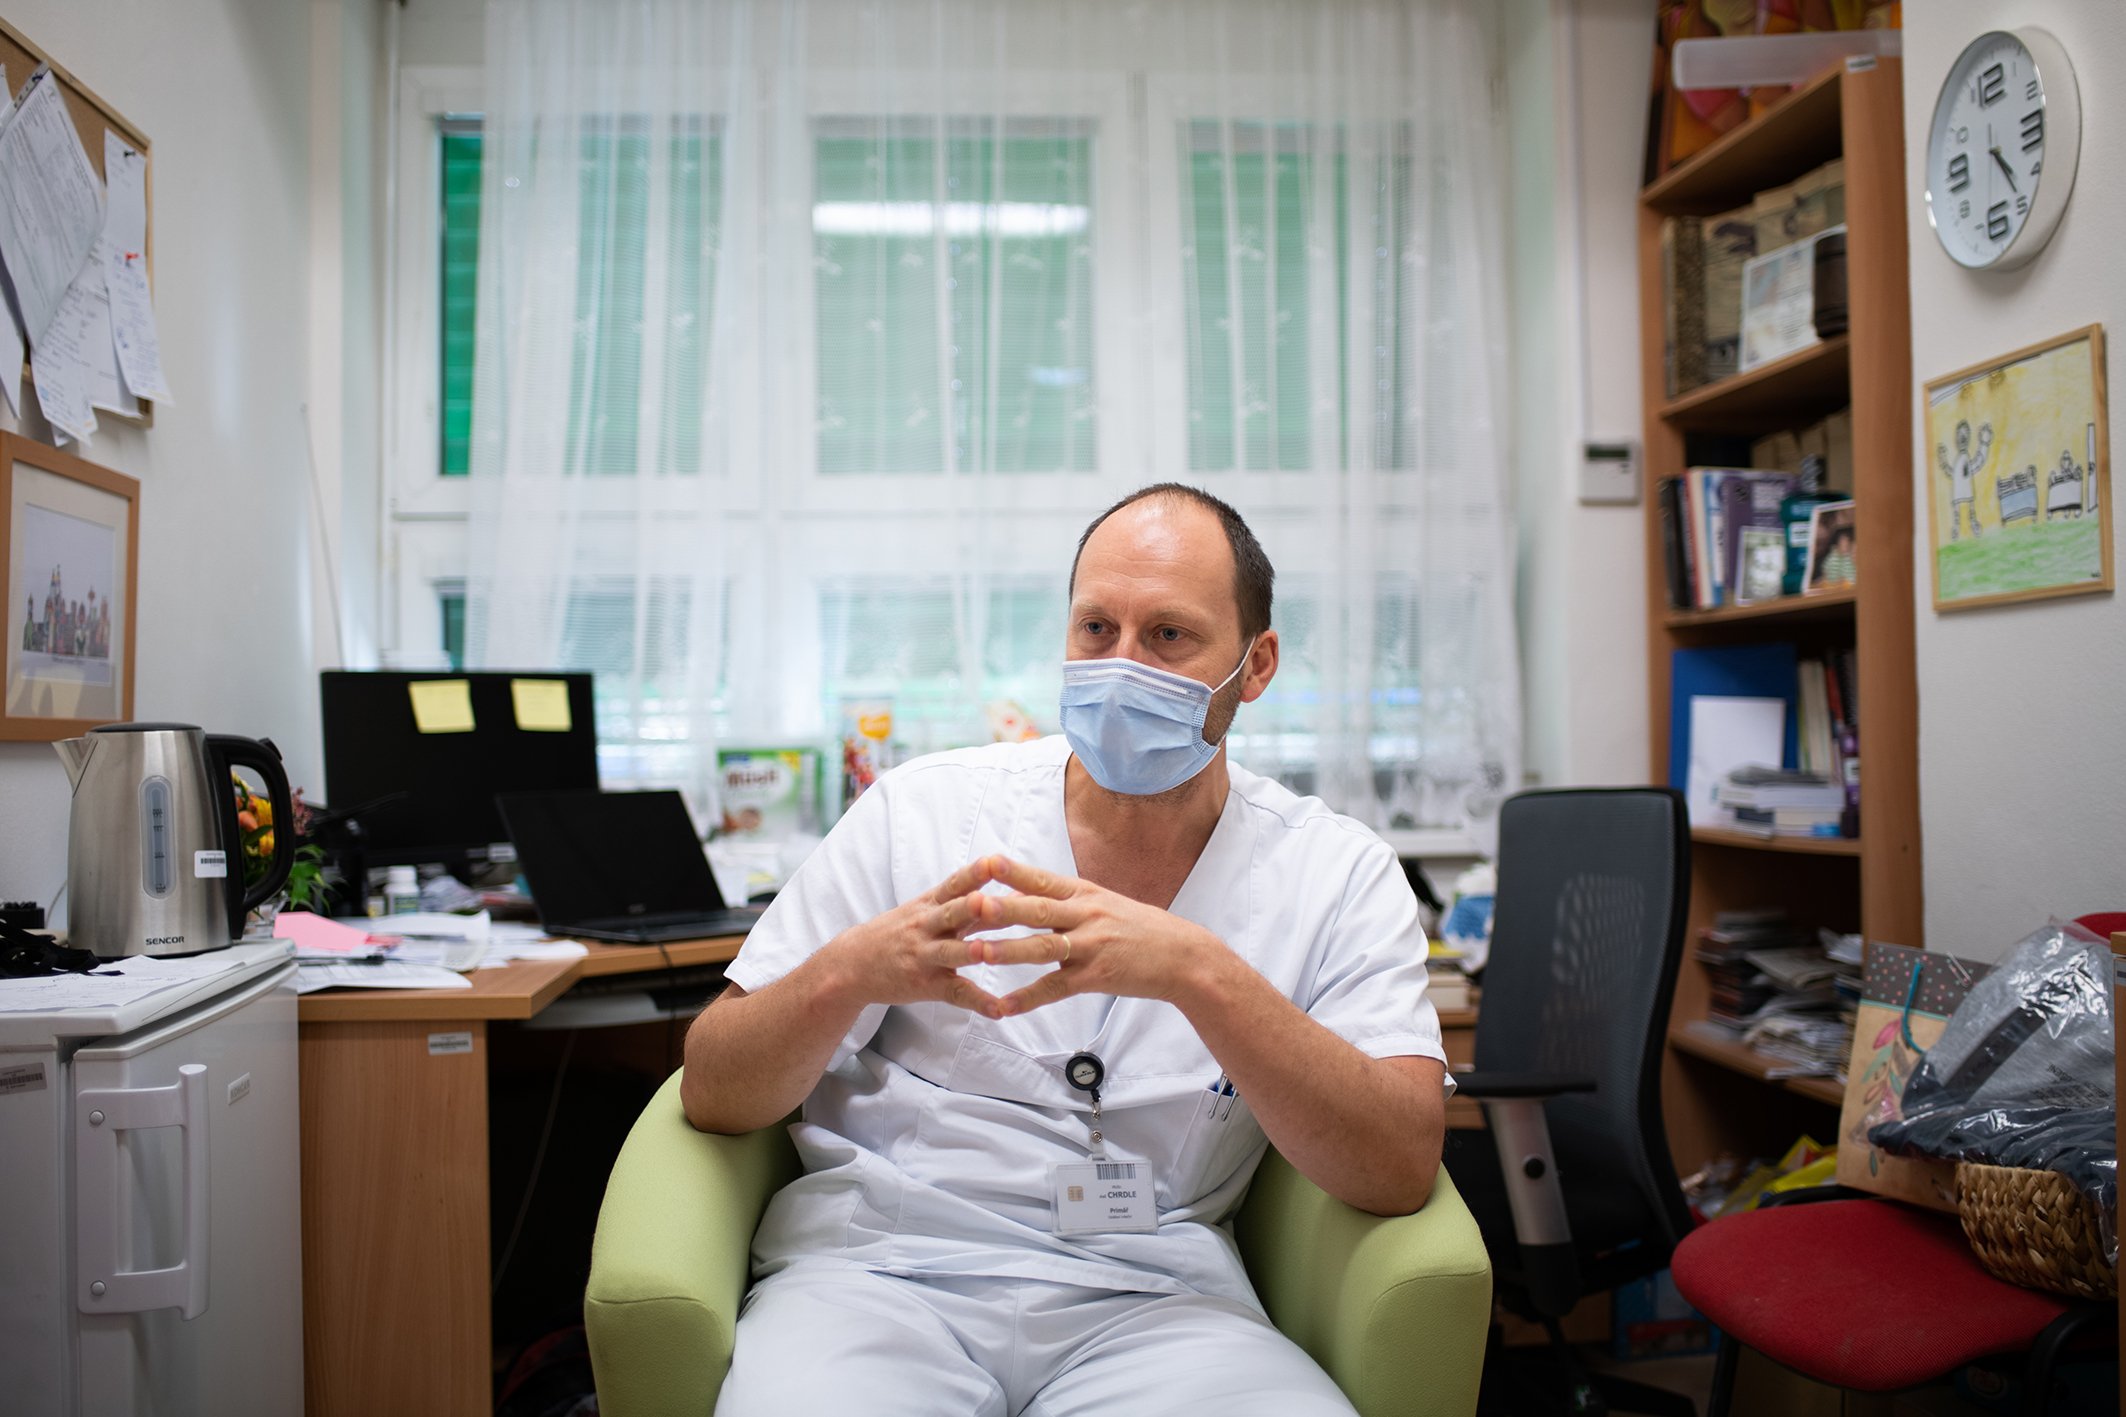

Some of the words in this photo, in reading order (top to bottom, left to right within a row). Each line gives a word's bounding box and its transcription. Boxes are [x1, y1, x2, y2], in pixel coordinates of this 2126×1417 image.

[1978, 62, 2005, 108] 12
[2026, 79, 2039, 101] 2
[2020, 108, 2043, 152] 3
[1949, 152, 1969, 192] 9
[2030, 161, 2041, 177] 4
[2016, 195, 2028, 216] 5
[1988, 200, 2009, 241] 6
[145, 935, 185, 946] SENCOR
[1107, 1190, 1137, 1199] CHRDLE
